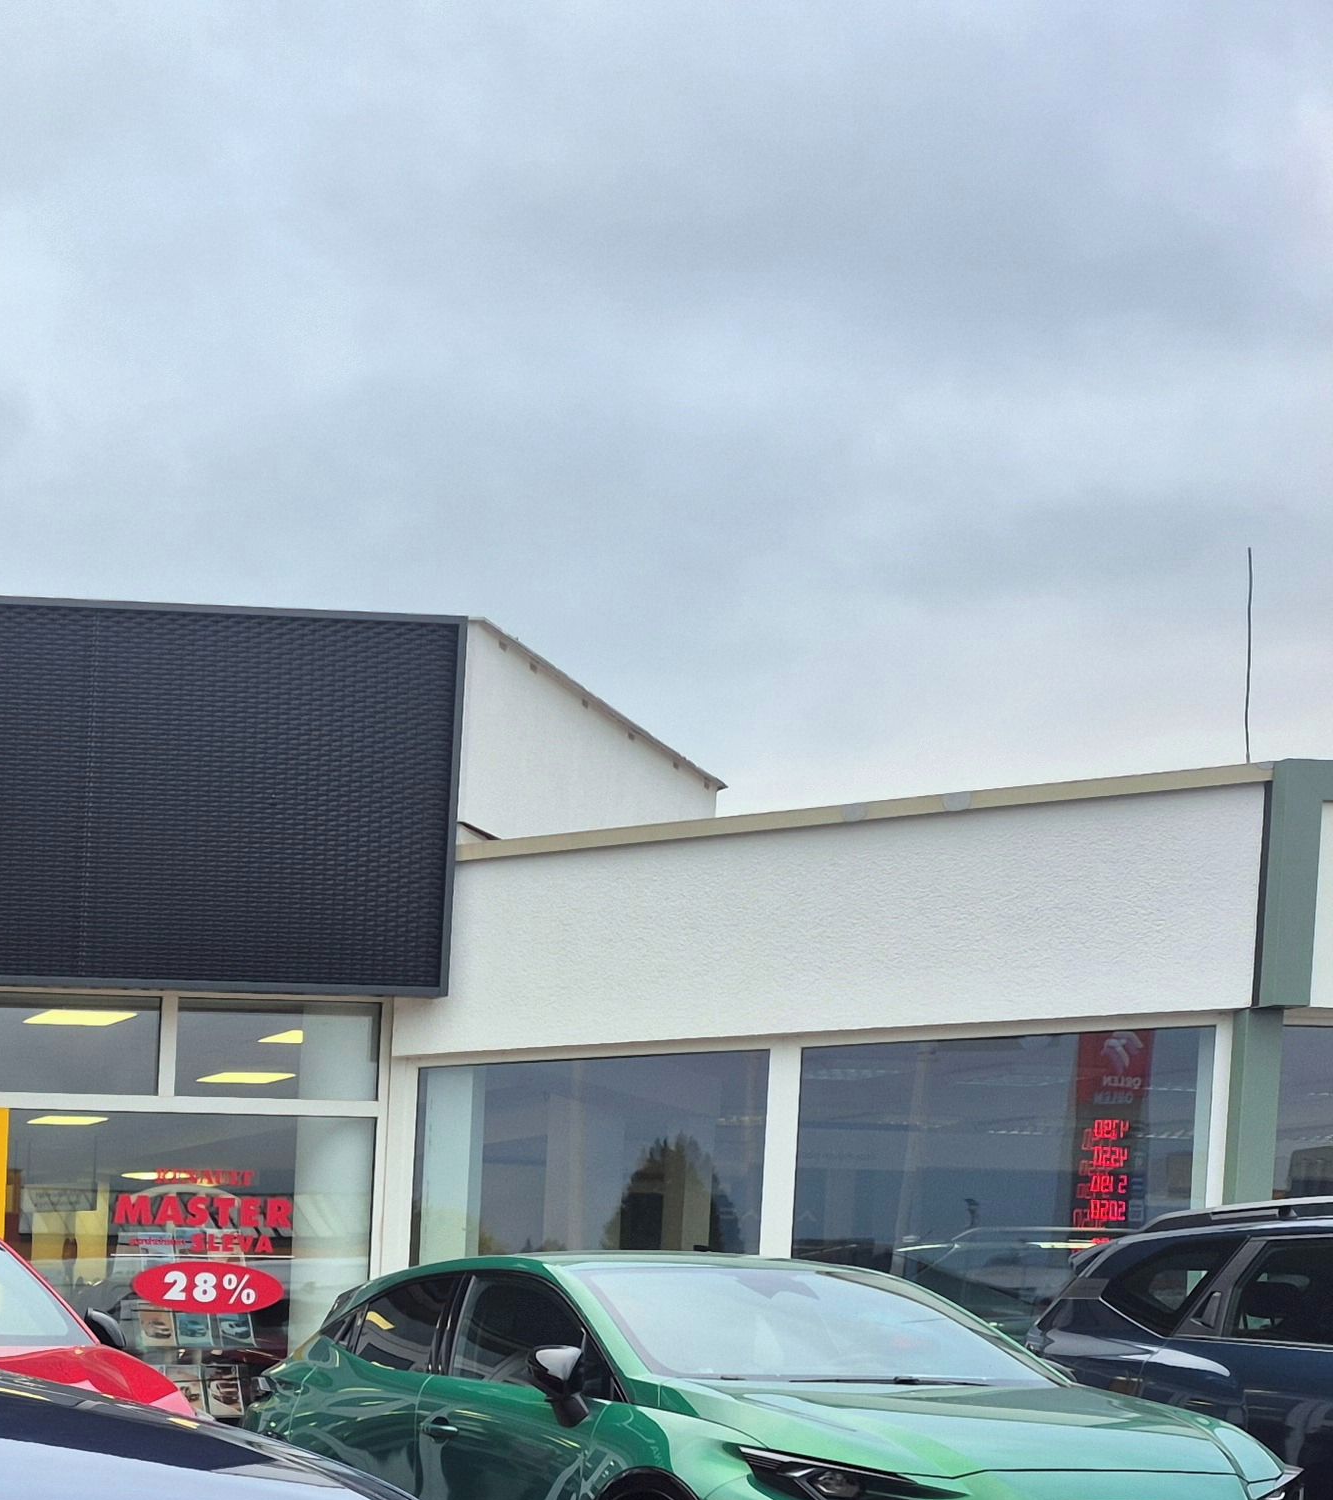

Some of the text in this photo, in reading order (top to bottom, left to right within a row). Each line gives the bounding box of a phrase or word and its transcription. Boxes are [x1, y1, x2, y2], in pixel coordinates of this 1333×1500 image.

[113, 1193, 293, 1229] MASTER
[190, 1232, 275, 1254] SLEVA
[161, 1270, 257, 1305] 28%
